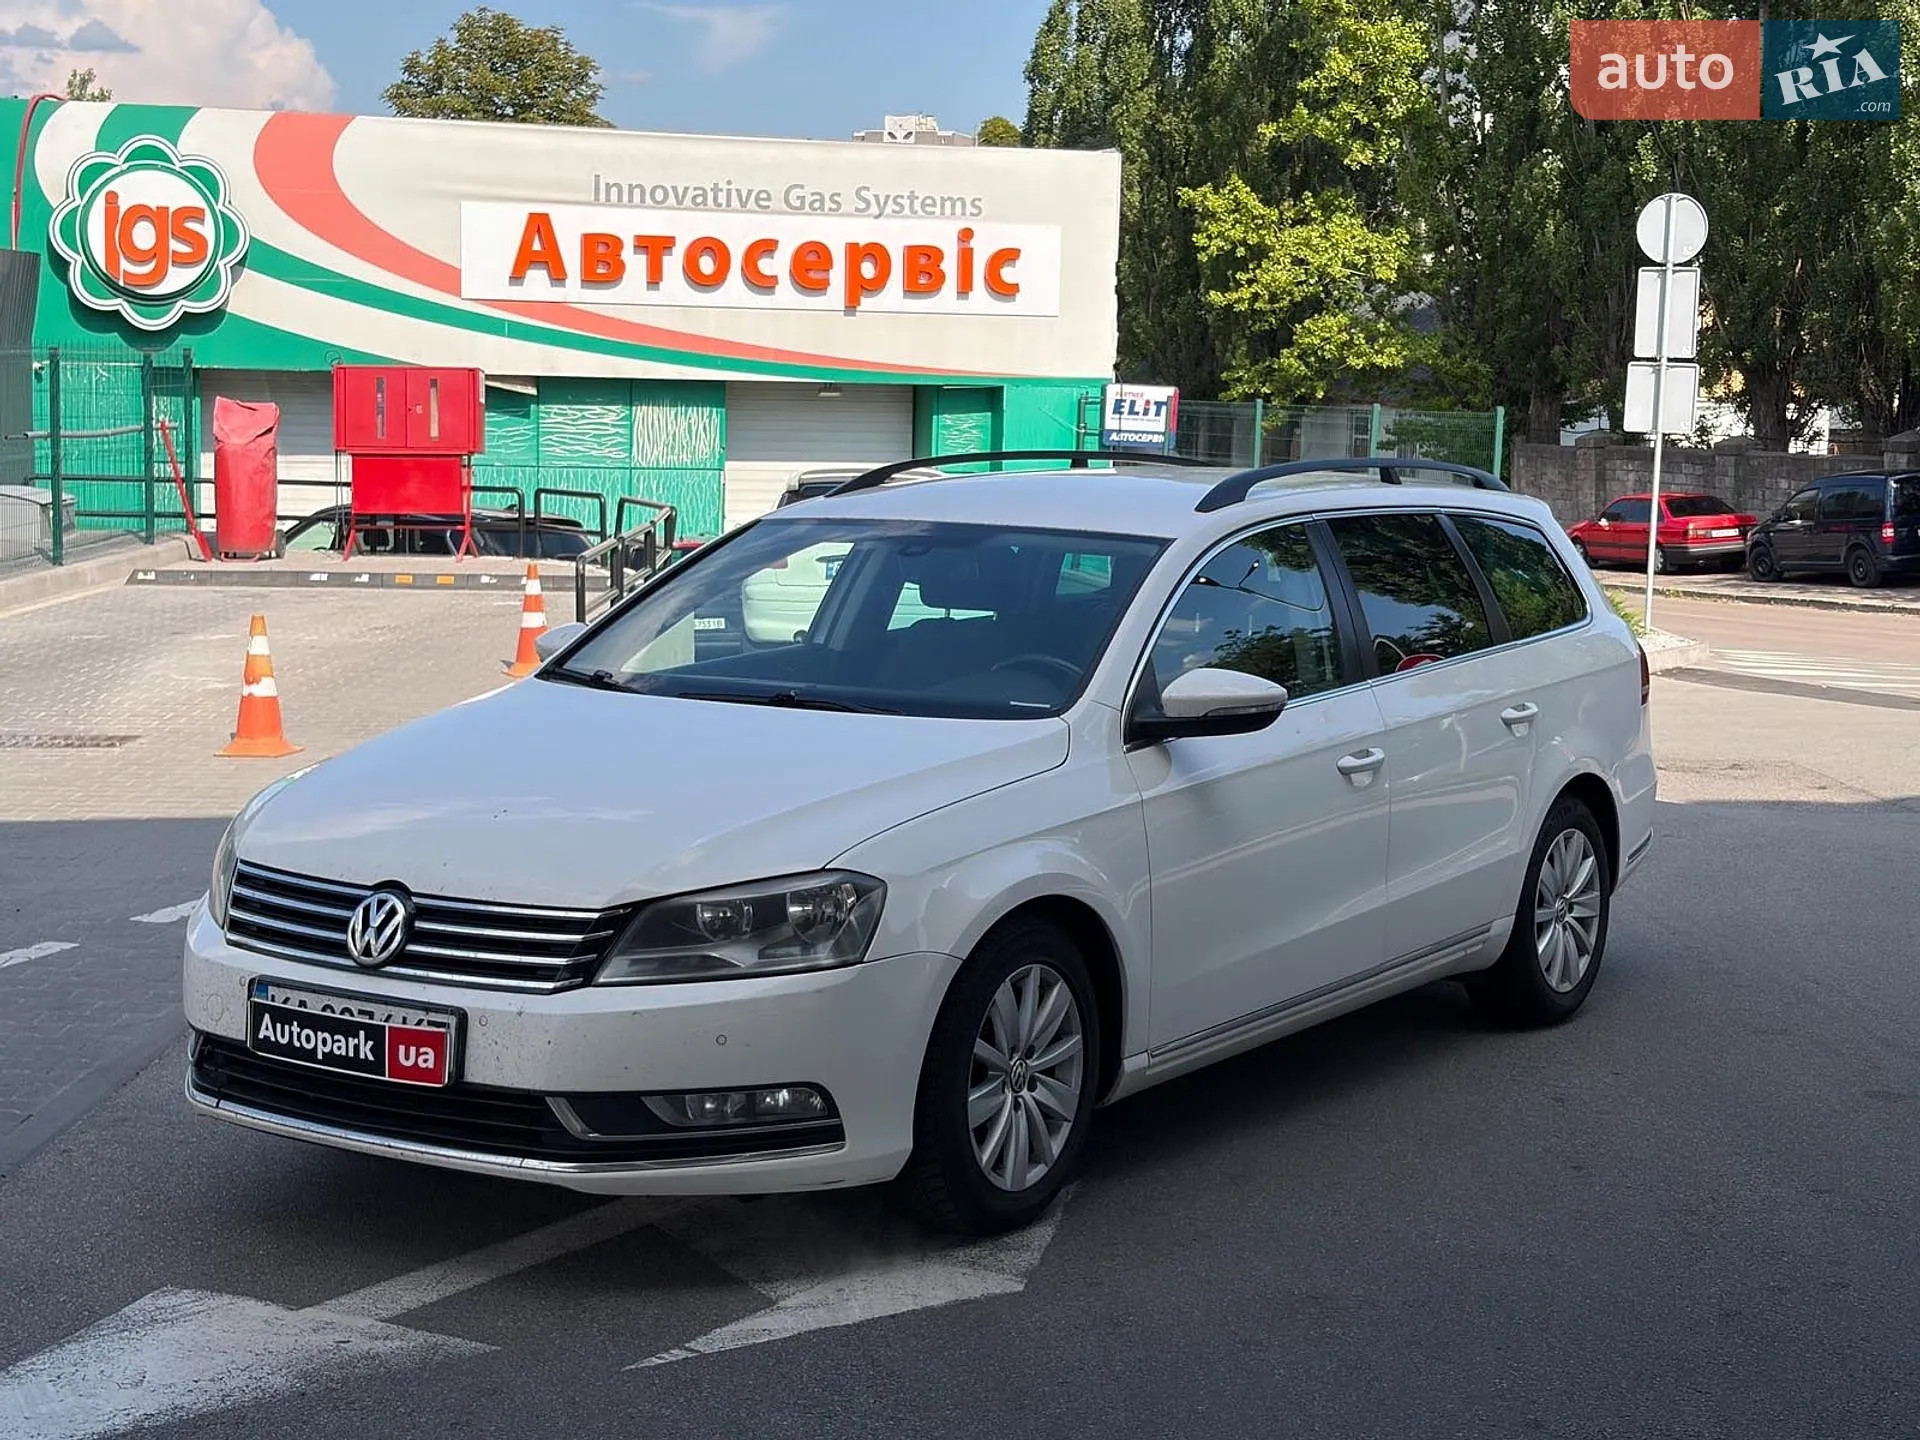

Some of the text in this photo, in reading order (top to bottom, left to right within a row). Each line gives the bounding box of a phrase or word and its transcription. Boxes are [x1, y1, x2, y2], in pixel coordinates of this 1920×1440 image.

[593, 173, 984, 220] Innovative Gas Systems
[104, 190, 210, 287] igs
[510, 211, 1022, 309] Автосервіс
[257, 1011, 376, 1061] Autopark
[397, 1043, 436, 1069] ua
